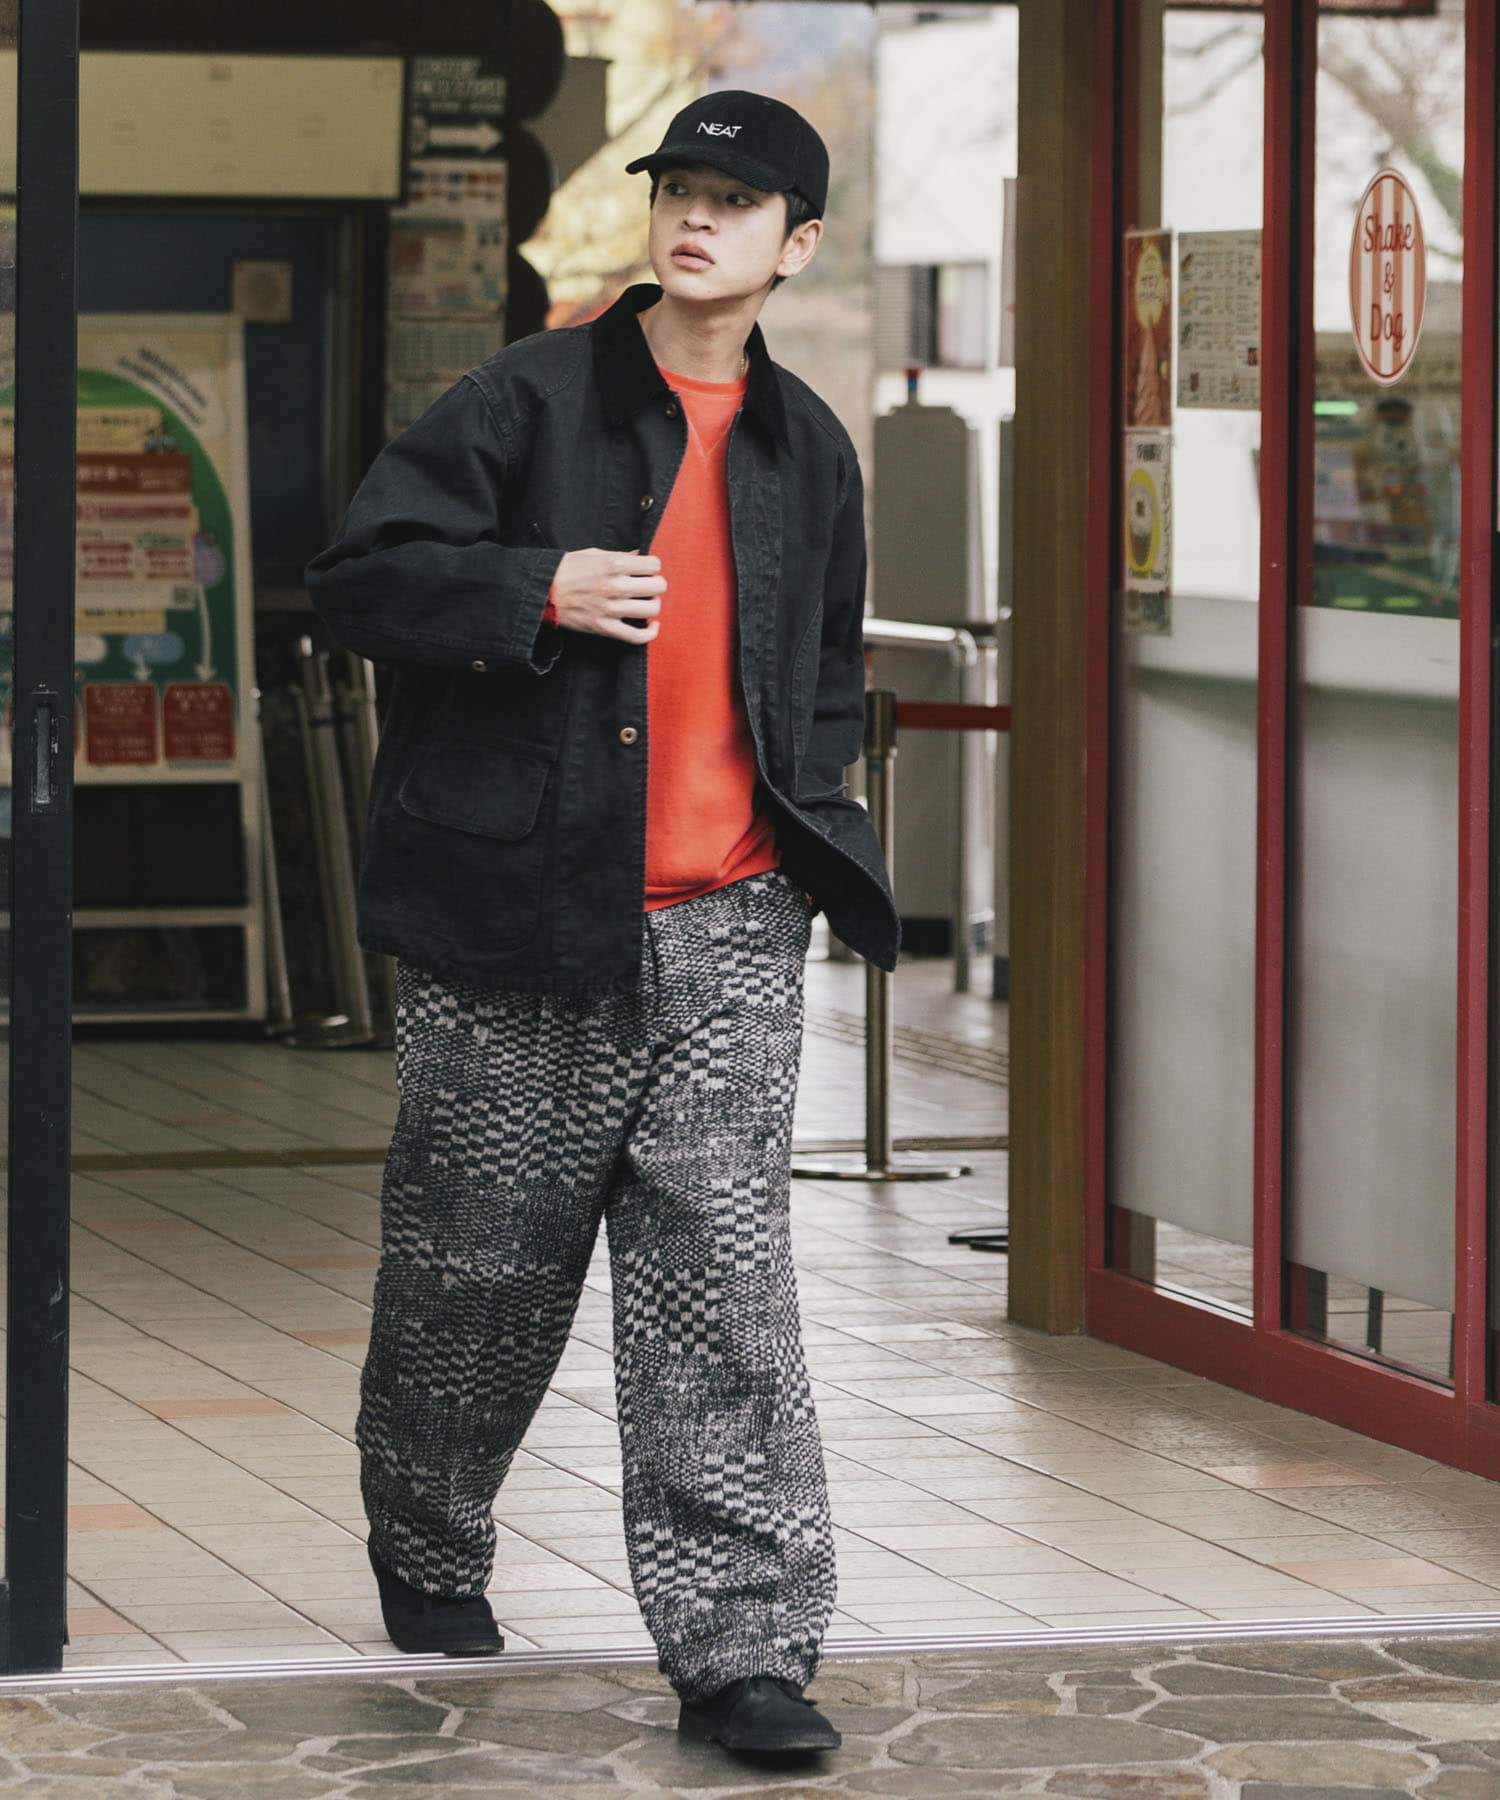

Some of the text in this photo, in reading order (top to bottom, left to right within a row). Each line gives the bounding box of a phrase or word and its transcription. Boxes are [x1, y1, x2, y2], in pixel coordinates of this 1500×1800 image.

[696, 121, 742, 138] NEAT
[1364, 212, 1415, 252] Shake
[1384, 261, 1395, 299] &
[1370, 303, 1406, 352] Dog
